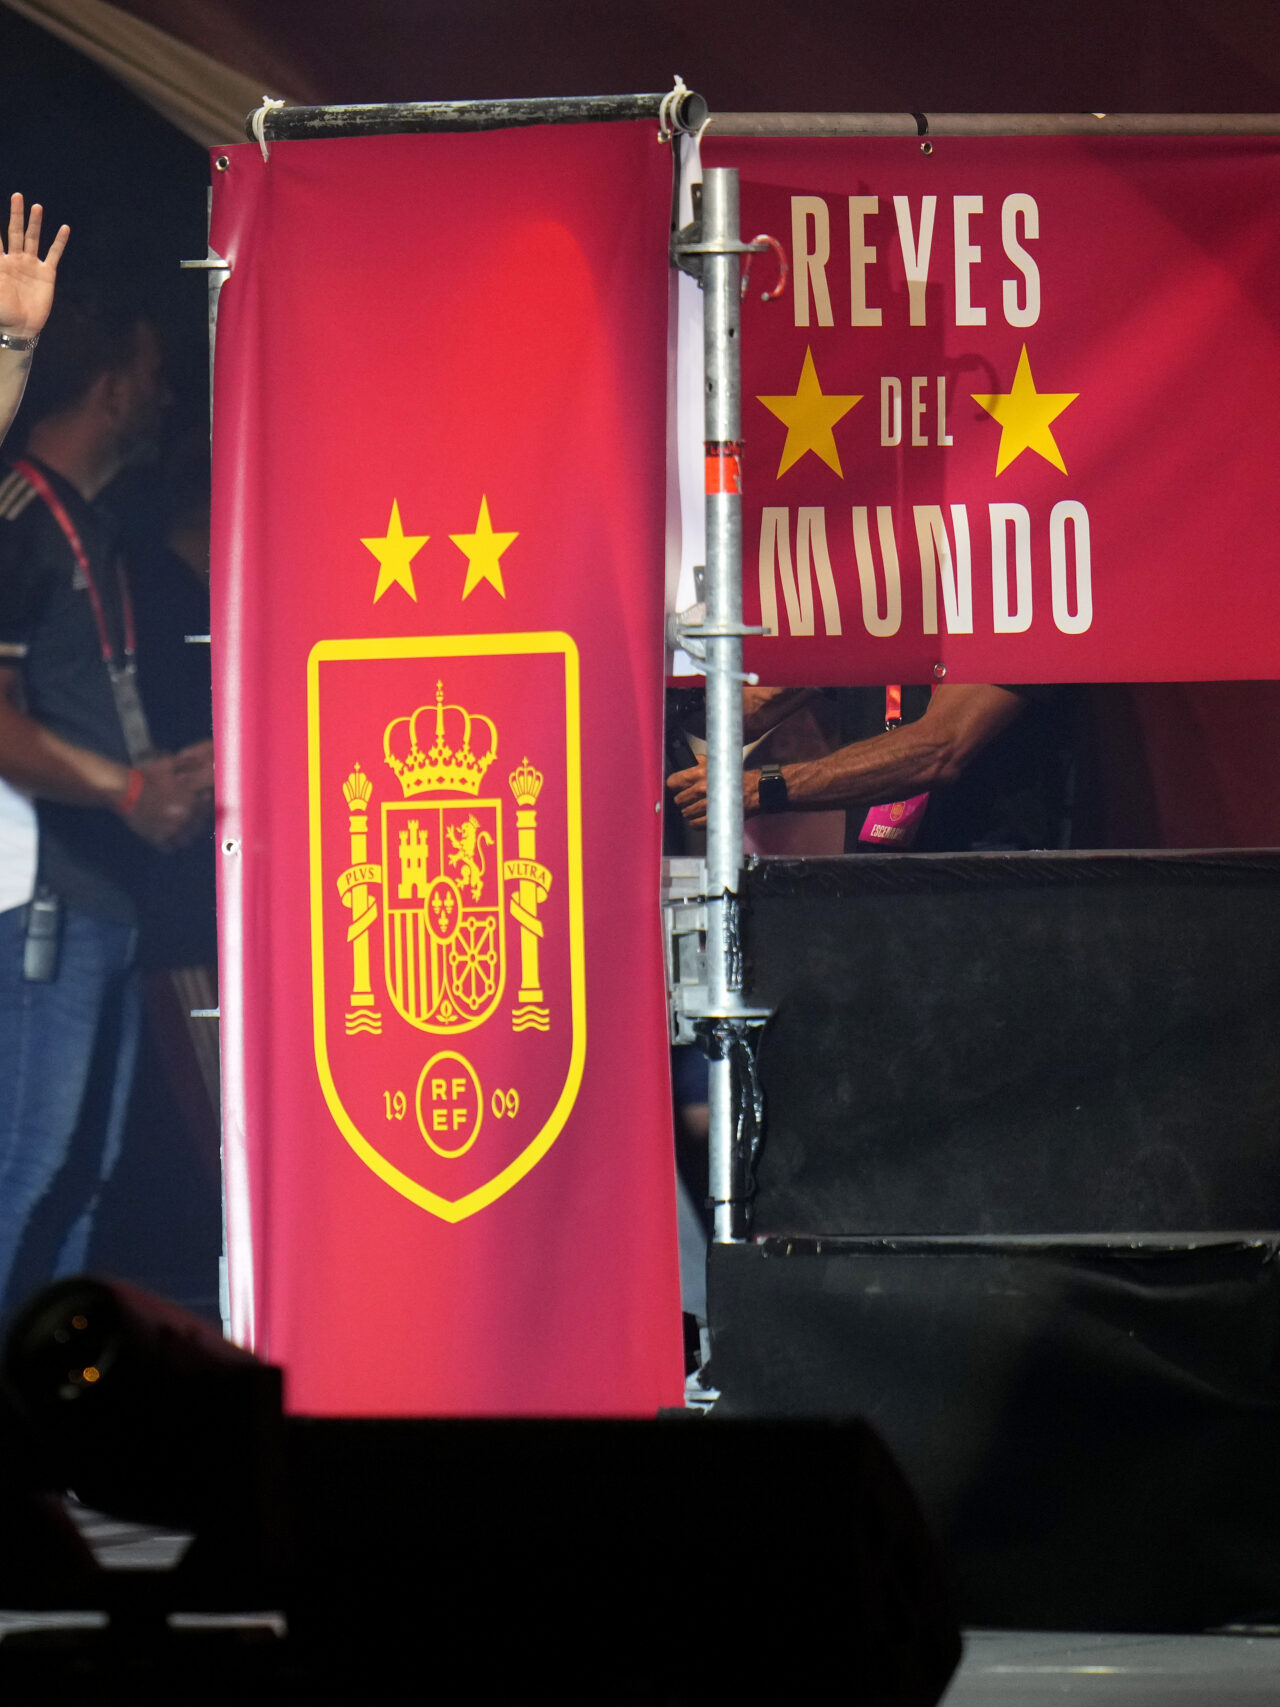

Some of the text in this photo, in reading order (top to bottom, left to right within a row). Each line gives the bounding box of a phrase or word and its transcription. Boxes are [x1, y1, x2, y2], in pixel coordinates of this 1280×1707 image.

[790, 192, 1041, 328] REYES
[880, 375, 954, 447] DEL
[758, 499, 1094, 638] MUNDO
[345, 865, 375, 886] PLVS
[506, 863, 547, 885] VLTRA
[431, 1077, 467, 1101] RF
[491, 1087, 520, 1120] 09
[382, 1090, 407, 1121] 19
[432, 1108, 468, 1131] EF
